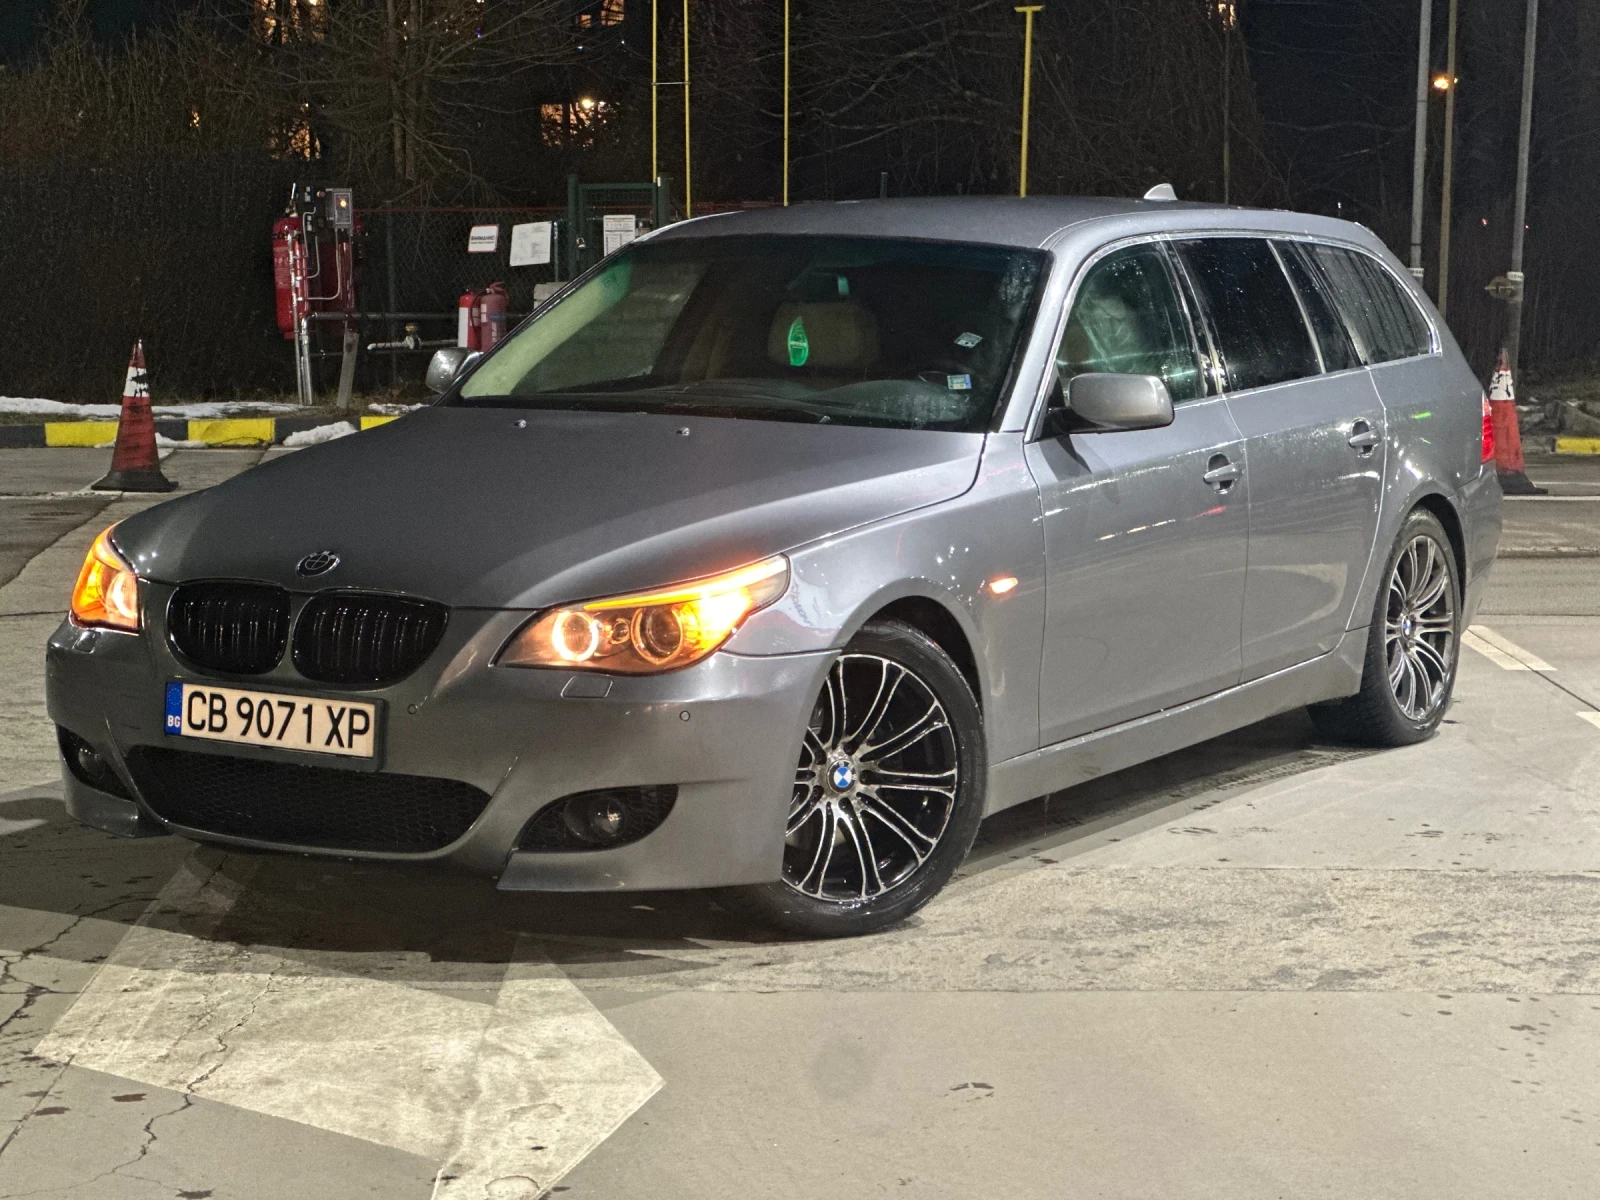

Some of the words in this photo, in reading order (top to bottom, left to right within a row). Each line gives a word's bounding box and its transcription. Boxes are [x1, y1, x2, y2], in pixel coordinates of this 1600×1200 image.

[167, 715, 181, 728] BG
[187, 691, 228, 732] CB
[236, 697, 313, 743] 9071
[324, 705, 370, 748] XP
